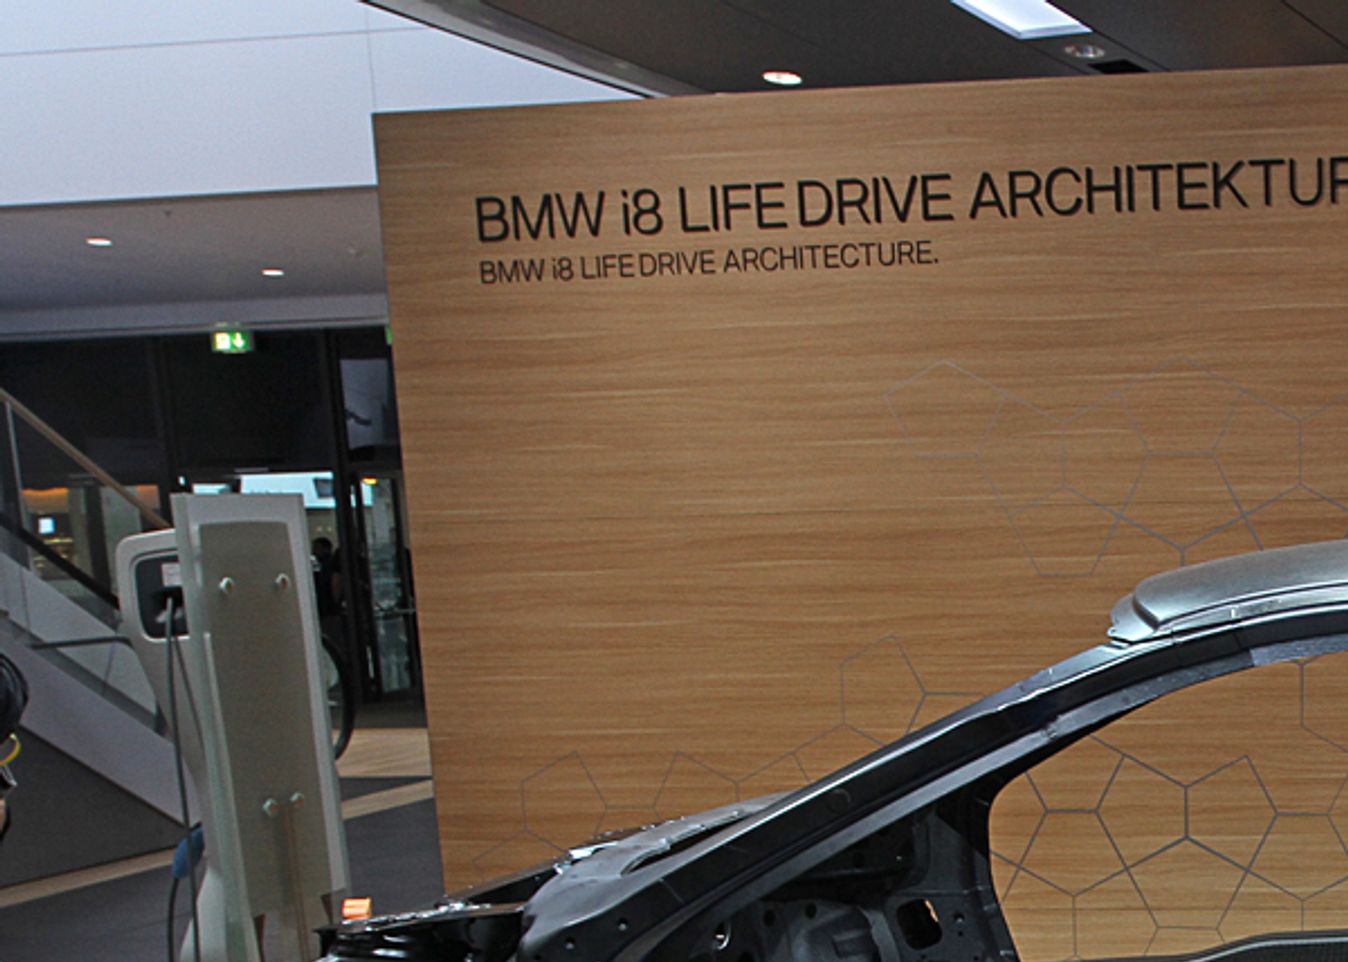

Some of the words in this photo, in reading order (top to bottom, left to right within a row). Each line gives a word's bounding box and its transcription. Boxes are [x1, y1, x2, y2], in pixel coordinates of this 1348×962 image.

[475, 190, 606, 243] BMW
[621, 188, 664, 236] i8
[678, 182, 788, 233] LIFE
[797, 174, 955, 228] DRIVE
[480, 258, 545, 284] BMW
[552, 256, 575, 281] i8
[723, 240, 939, 273] ARCHITECTURE.
